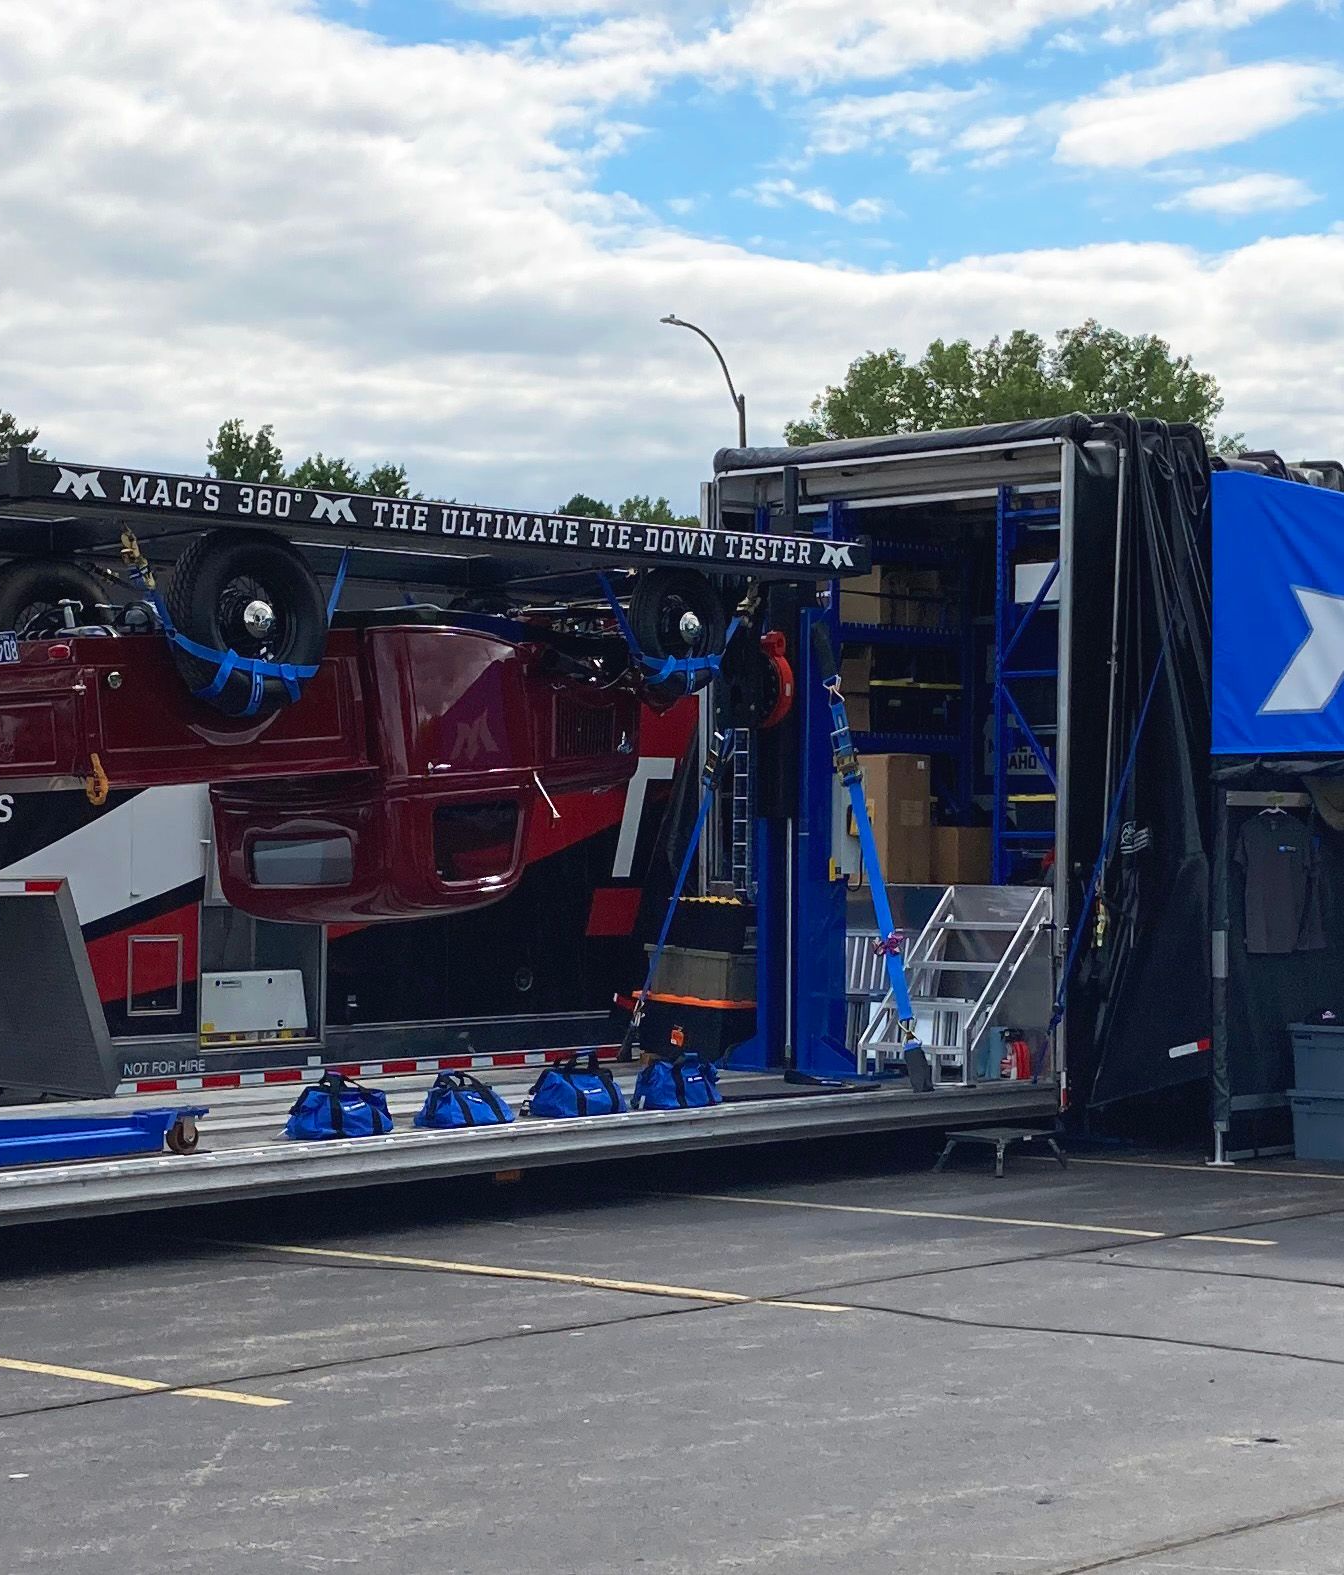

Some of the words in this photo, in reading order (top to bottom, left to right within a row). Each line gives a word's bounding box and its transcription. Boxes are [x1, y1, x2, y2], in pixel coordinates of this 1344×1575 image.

[120, 475, 221, 512] MAC'S
[371, 501, 430, 532] THE
[440, 508, 579, 547] ULTIMATE
[588, 522, 717, 558] TIE-DOWN
[725, 535, 812, 565] TESTER
[123, 1062, 149, 1076] NOT
[152, 1060, 176, 1074] FOR
[179, 1059, 206, 1072] HIRE
